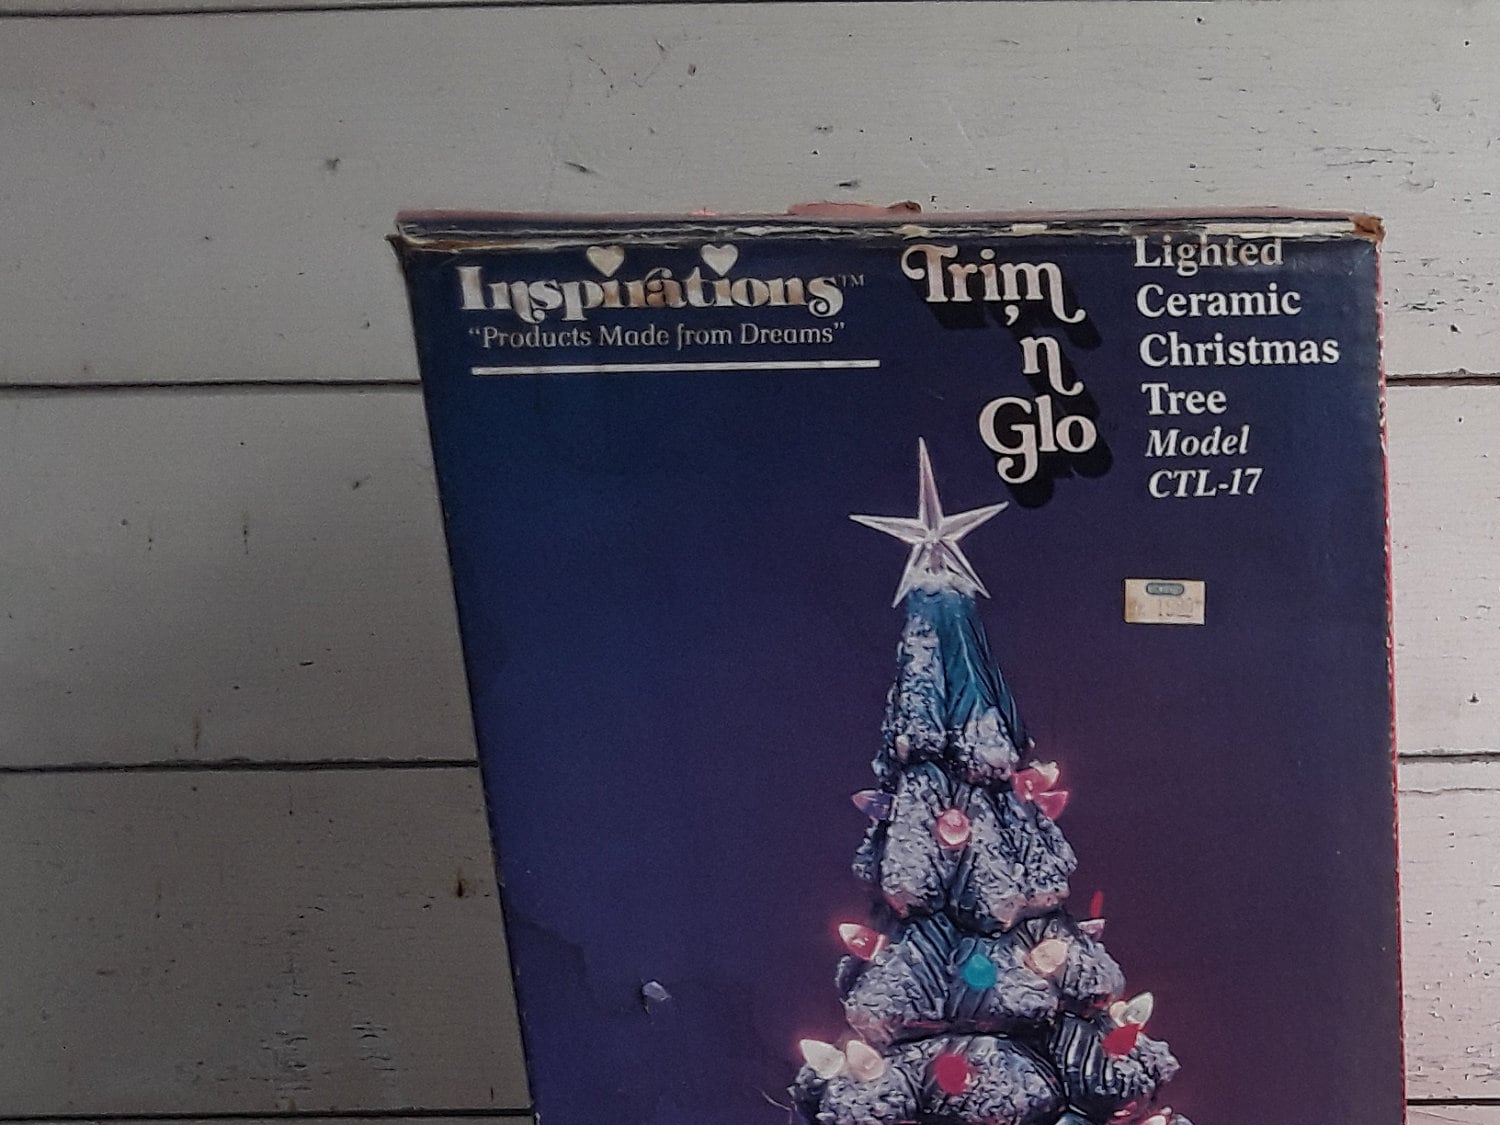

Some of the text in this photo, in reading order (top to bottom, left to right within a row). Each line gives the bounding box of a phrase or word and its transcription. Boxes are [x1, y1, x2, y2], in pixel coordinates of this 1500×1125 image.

[1133, 231, 1284, 277] Lighted
[456, 244, 844, 323] Inspirations
[901, 244, 1086, 323] Trim
[1136, 283, 1302, 318] Ceramic
[599, 324, 670, 346] Made
[677, 322, 733, 350] from
[1138, 333, 1341, 368] Christmas
[1141, 382, 1228, 416] Tree
[978, 394, 1097, 484] Glo
[1145, 425, 1250, 458] Model
[1148, 467, 1264, 499] CTL-17
